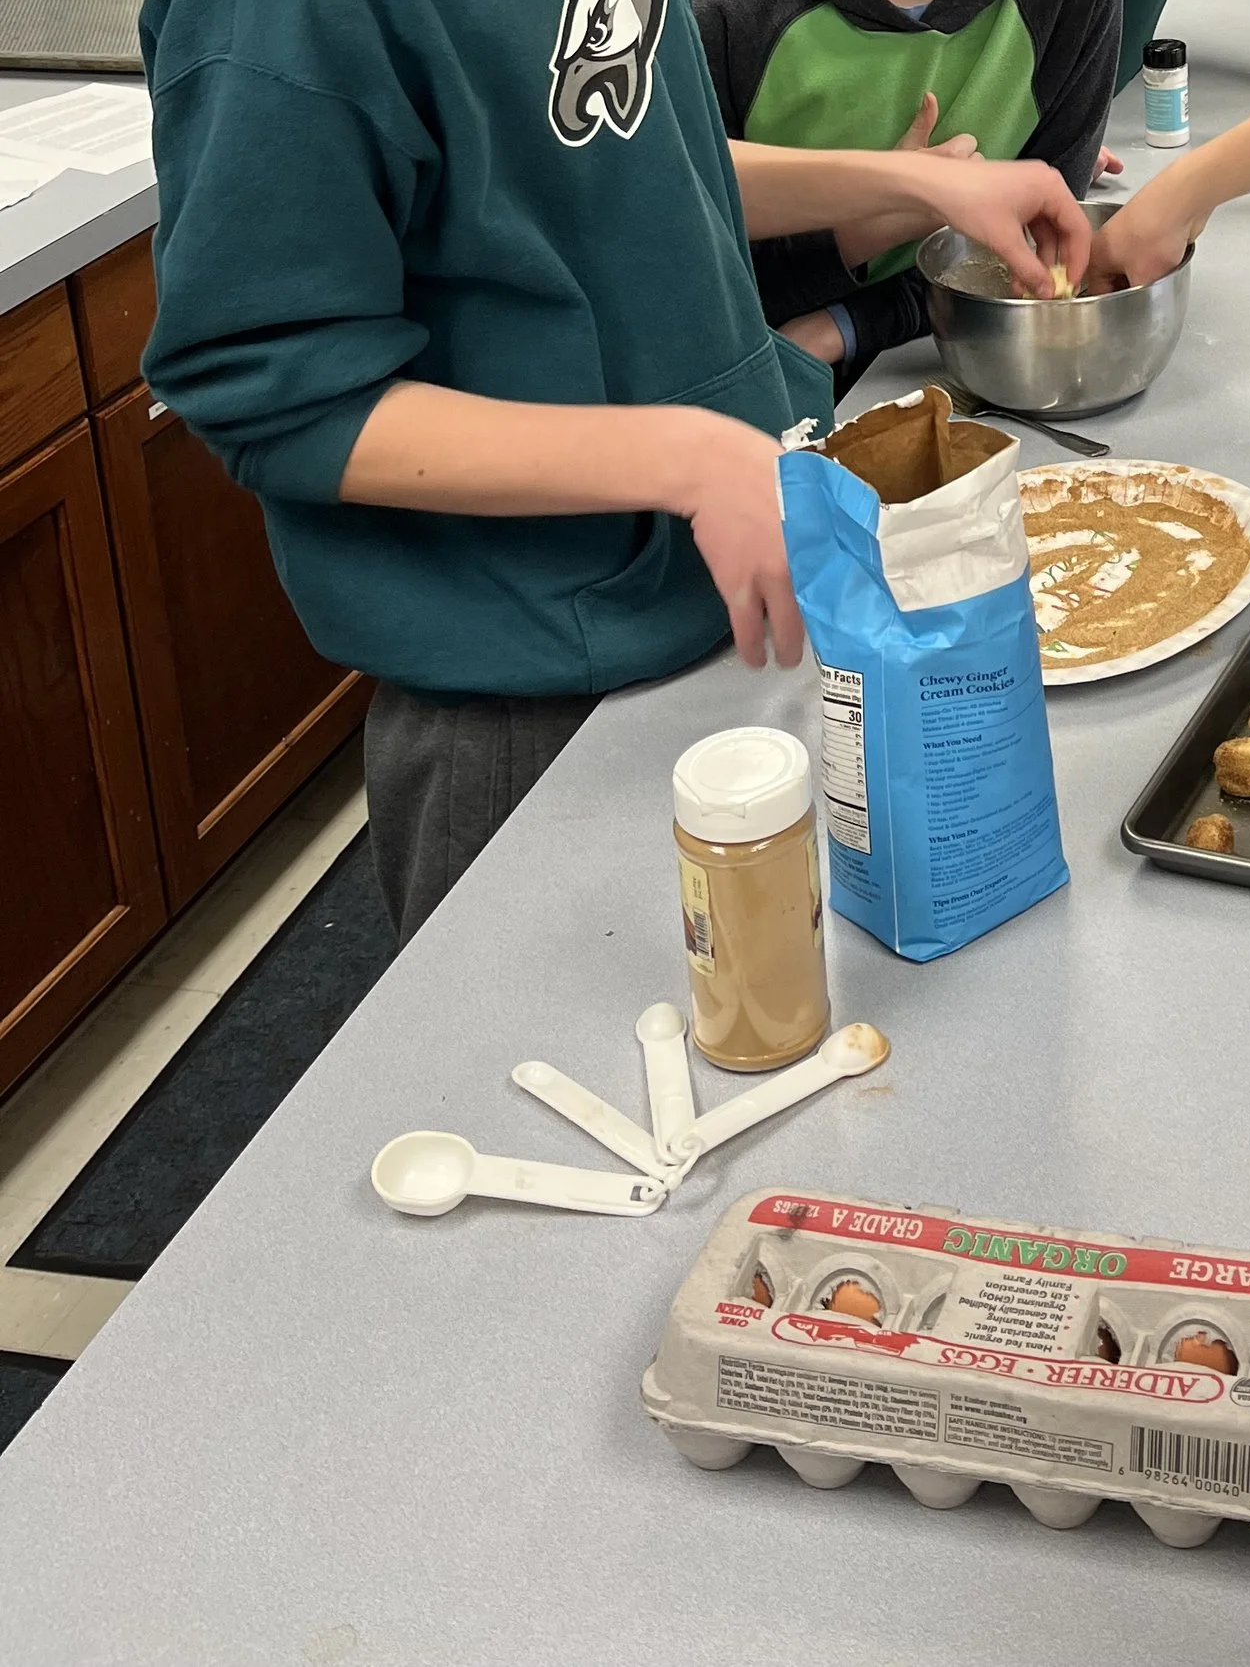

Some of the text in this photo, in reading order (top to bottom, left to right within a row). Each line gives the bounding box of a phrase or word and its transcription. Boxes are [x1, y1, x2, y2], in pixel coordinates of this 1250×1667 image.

[834, 670, 861, 686] Facts
[920, 666, 1008, 687] Chewy Ginger
[920, 677, 1015, 701] Cream Cookies
[849, 710, 862, 723] 30
[923, 734, 982, 750] What You Need
[929, 836, 951, 844] What
[951, 832, 966, 840] You
[933, 874, 1009, 908] Tips from Our Experts
[832, 1208, 924, 1240] GRADE A
[942, 1227, 1128, 1277] ORGANIC
[986, 1282, 1048, 1296] Generation
[1003, 1274, 1073, 1292] Family Farm
[959, 1296, 998, 1312] Modified
[979, 1290, 1066, 1312] Organisms (GMOs)
[715, 1302, 765, 1321] DOZEN
[1000, 1305, 1047, 1320] Genetically
[718, 1317, 749, 1328] ONE
[986, 1313, 1060, 1332] Free Roaming
[964, 1331, 1053, 1353] Hens fed organic
[1001, 1328, 1056, 1341] vegetarian
[938, 1348, 1201, 1398] ALDERFER EGGS
[1118, 1466, 1125, 1476] 6
[1144, 1469, 1188, 1487] 98264
[1195, 1479, 1240, 1498] 00040
